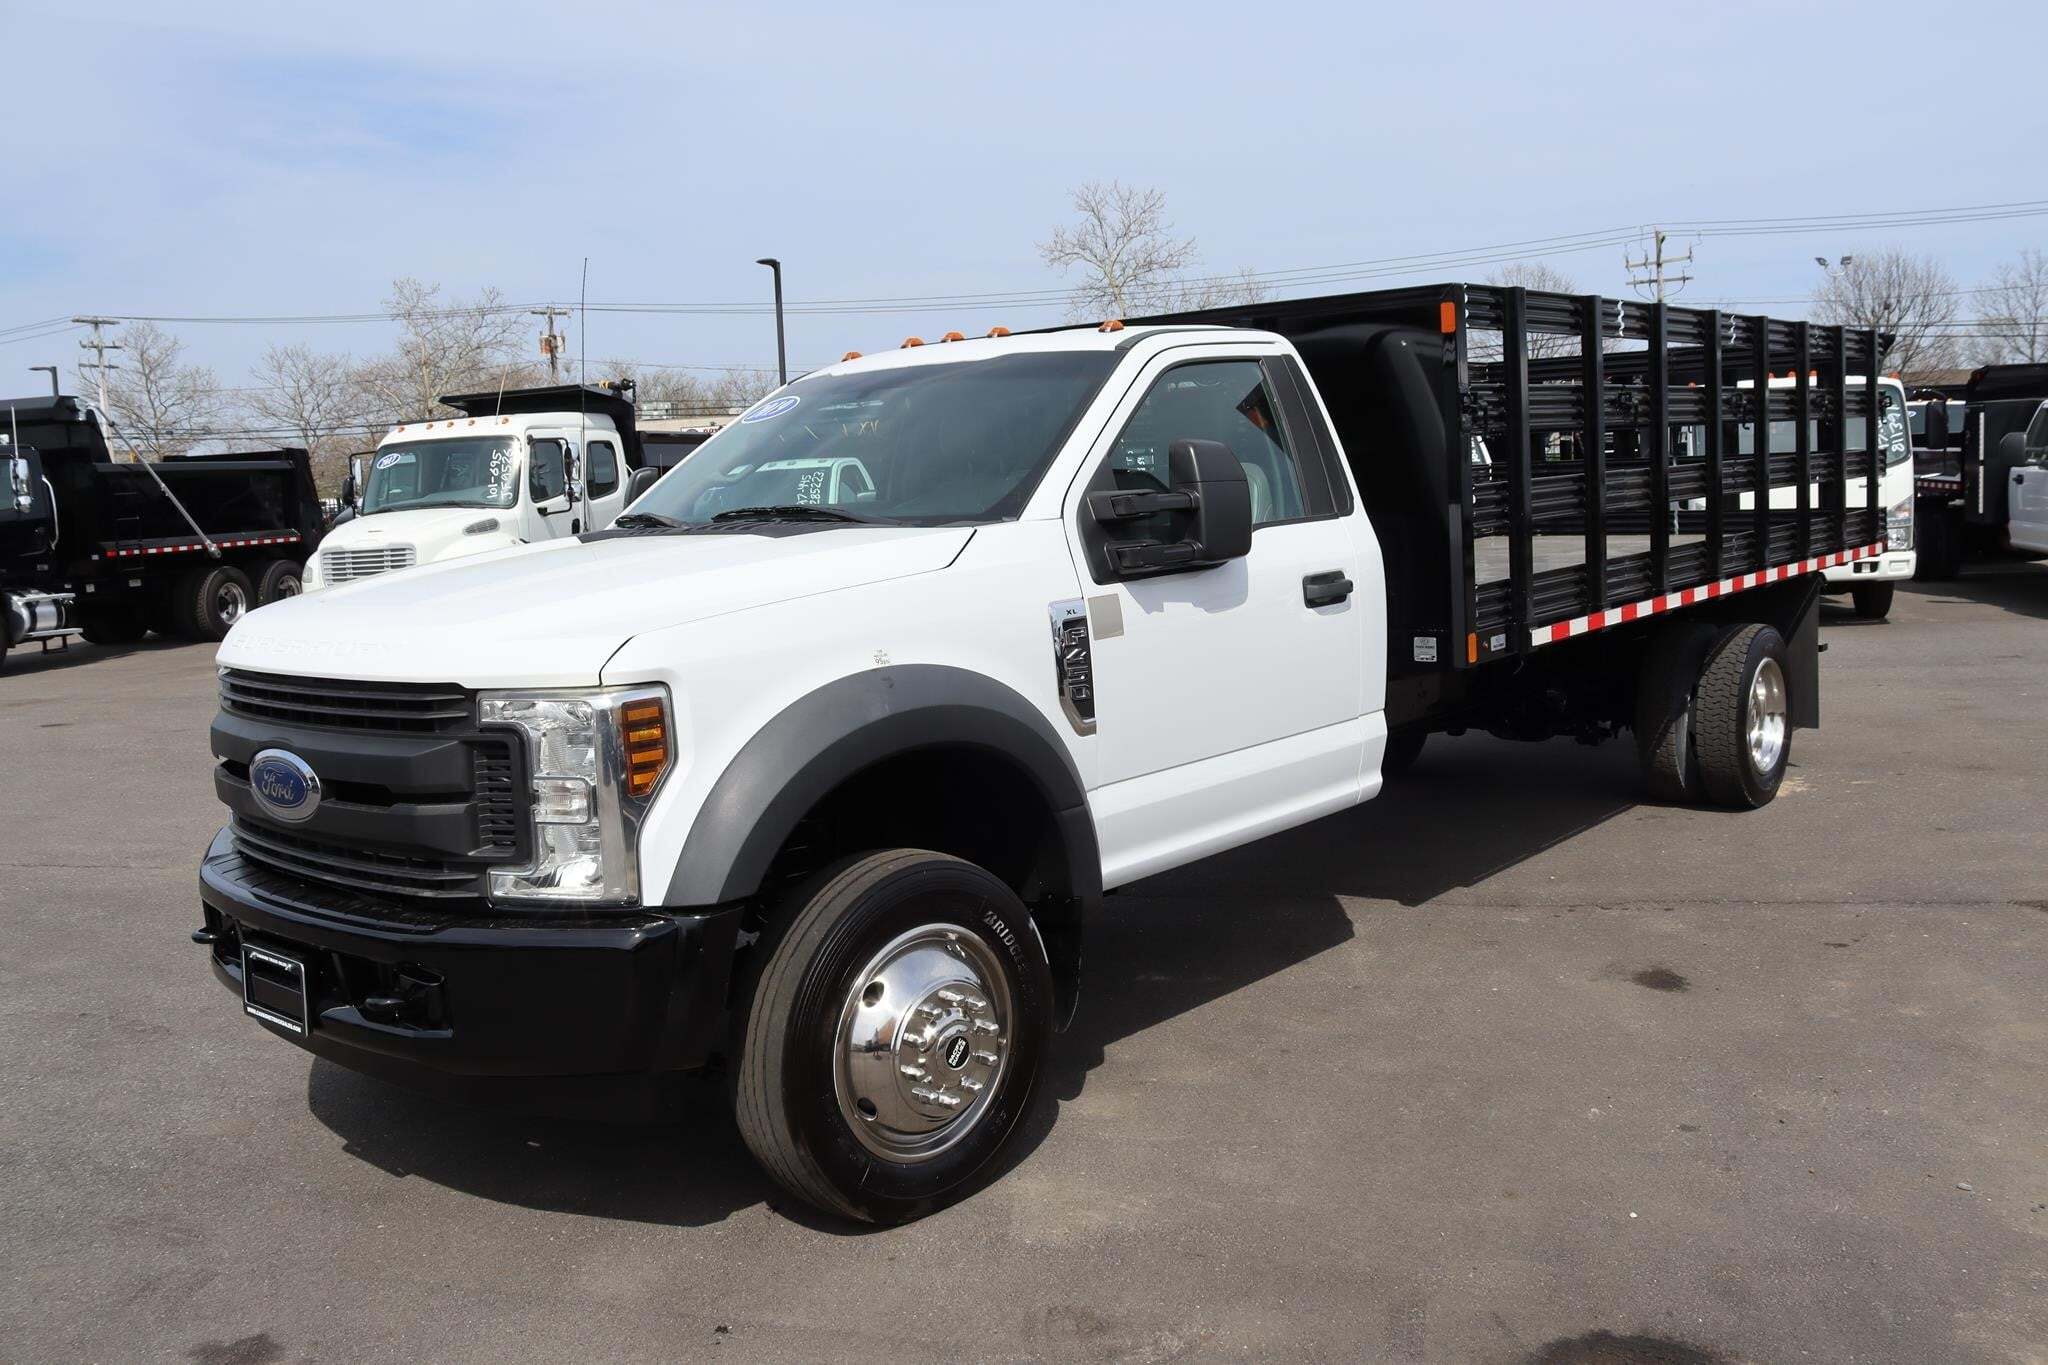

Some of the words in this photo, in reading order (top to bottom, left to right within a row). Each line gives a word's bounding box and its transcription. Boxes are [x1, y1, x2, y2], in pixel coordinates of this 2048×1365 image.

[486, 449, 502, 499] 101-695
[1065, 608, 1077, 616] XL
[261, 766, 295, 801] Ford
